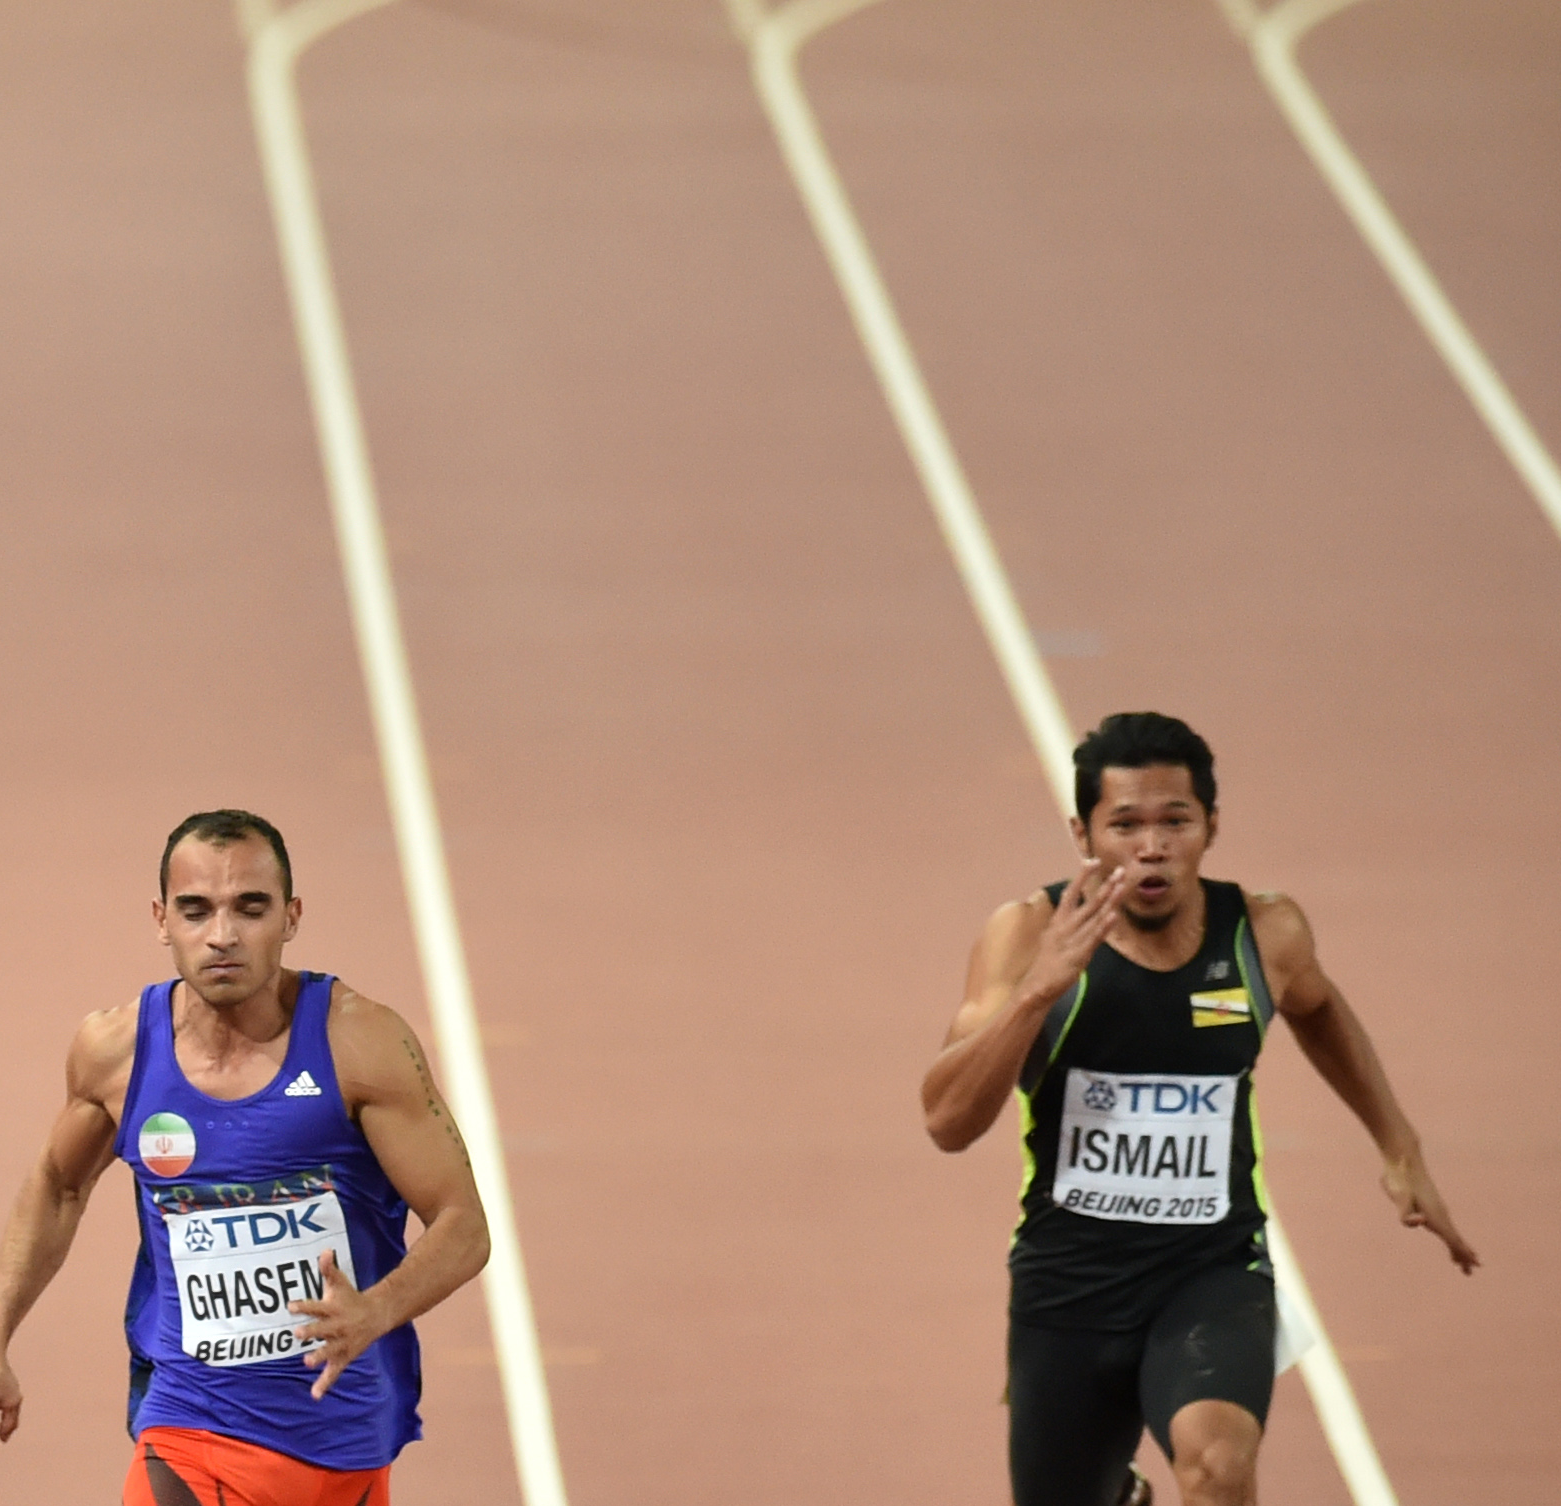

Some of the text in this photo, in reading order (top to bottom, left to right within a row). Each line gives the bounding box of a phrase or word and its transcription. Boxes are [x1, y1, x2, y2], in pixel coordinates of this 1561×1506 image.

[1119, 1082, 1223, 1114] TDK
[1068, 1127, 1217, 1178] ISMAIL
[1063, 1188, 1218, 1218] BEIJING 2015
[211, 1202, 327, 1249] TDK
[195, 1330, 293, 1362] BEIJING
